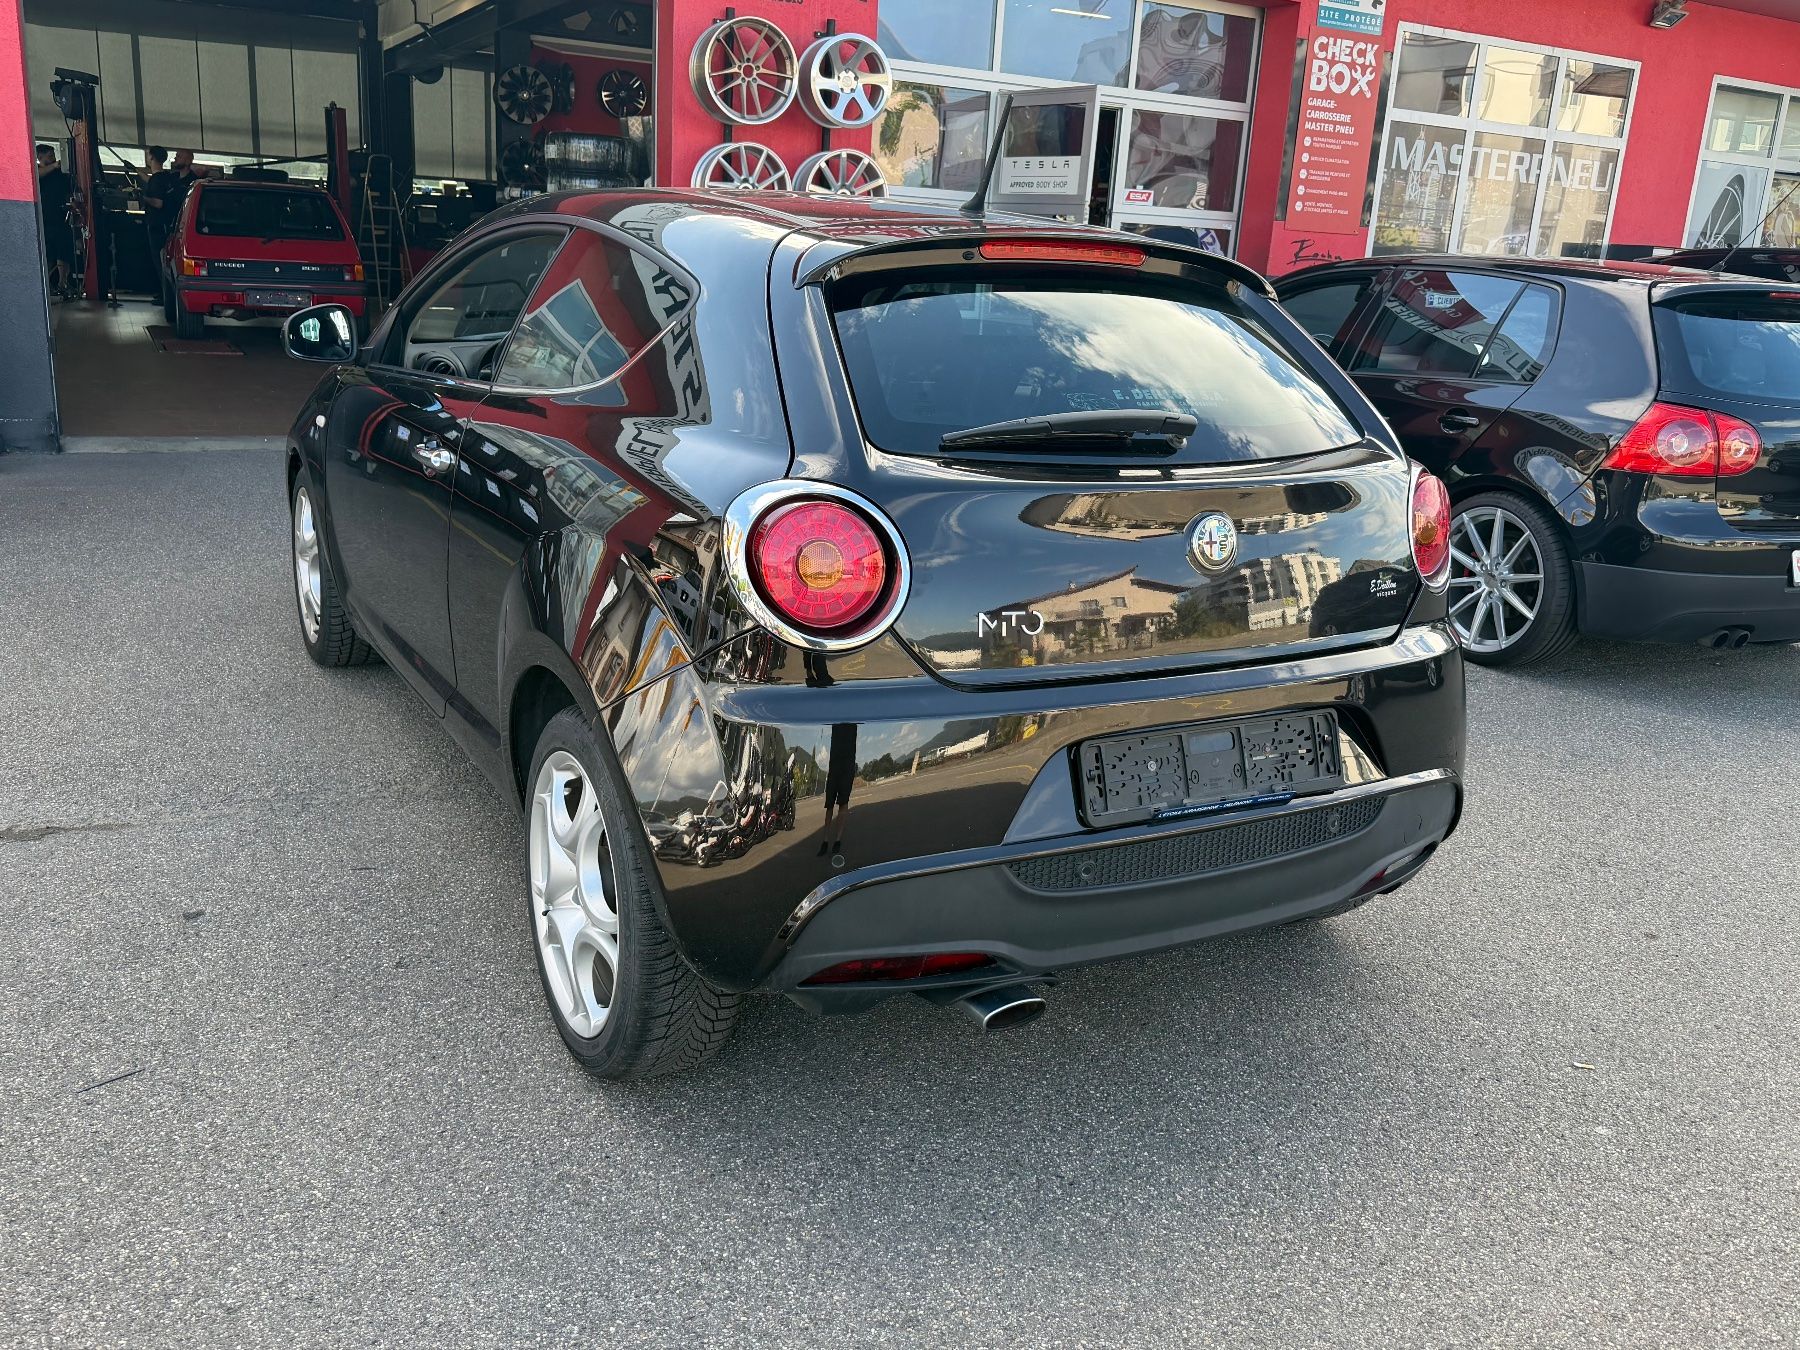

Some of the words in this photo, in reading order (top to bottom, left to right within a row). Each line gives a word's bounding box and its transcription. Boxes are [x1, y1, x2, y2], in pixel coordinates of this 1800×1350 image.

[1320, 9, 1340, 20] SITE
[1313, 35, 1380, 67] CHECK
[1309, 58, 1376, 99] BOX
[1307, 96, 1338, 109] GARAGE-
[1306, 109, 1352, 123] CARROSSERIE
[1304, 121, 1334, 132] MASTER
[1334, 124, 1355, 135] PNEU
[1012, 160, 1070, 169] TESLA
[1009, 180, 1035, 188] APPROVED
[1036, 180, 1051, 188] BODY
[1052, 180, 1068, 188] SHOP
[214, 261, 246, 269] PEUGEOT
